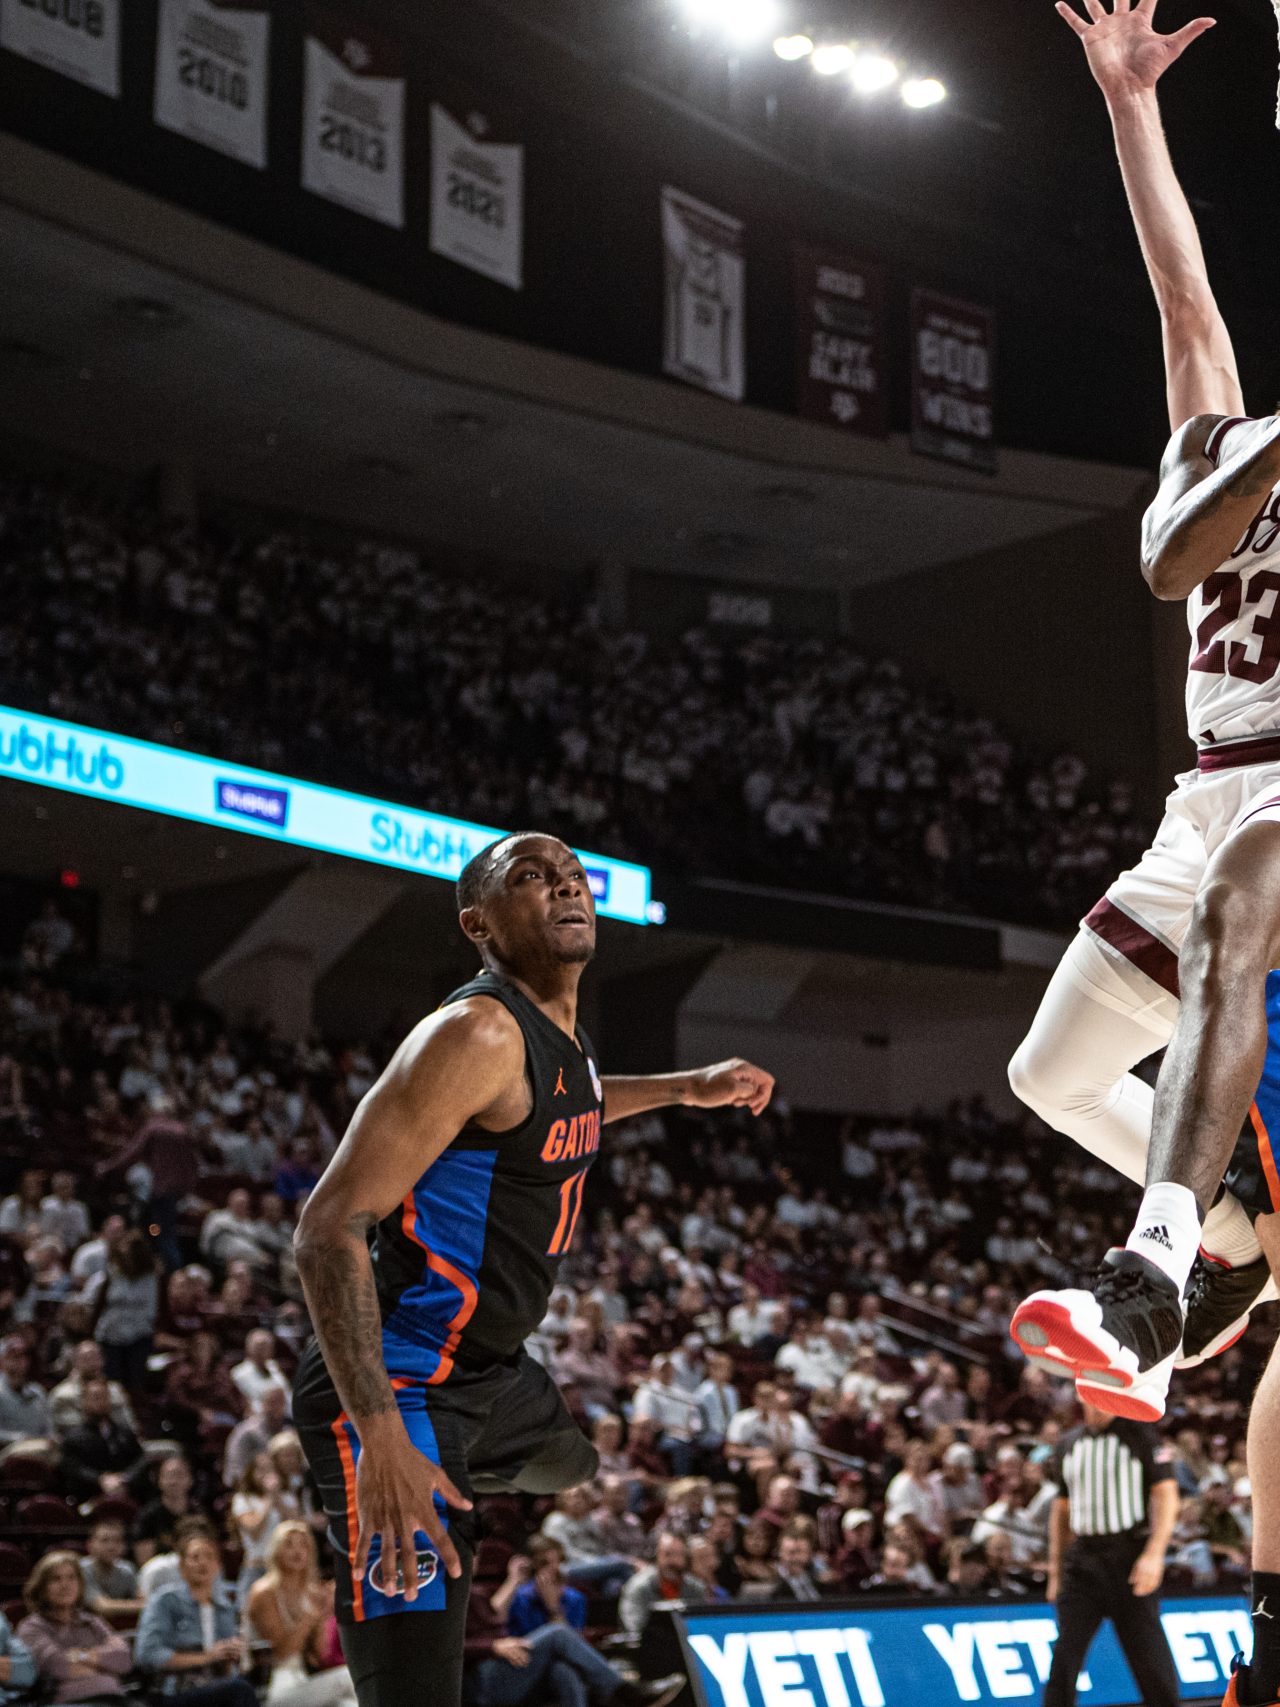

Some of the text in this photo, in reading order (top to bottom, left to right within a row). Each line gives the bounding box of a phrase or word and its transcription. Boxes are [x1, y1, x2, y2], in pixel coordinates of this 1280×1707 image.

[178, 48, 249, 109] 2010
[546, 1166, 588, 1257] 11
[1139, 1229, 1173, 1251] adidas
[687, 1627, 887, 1707] YETI
